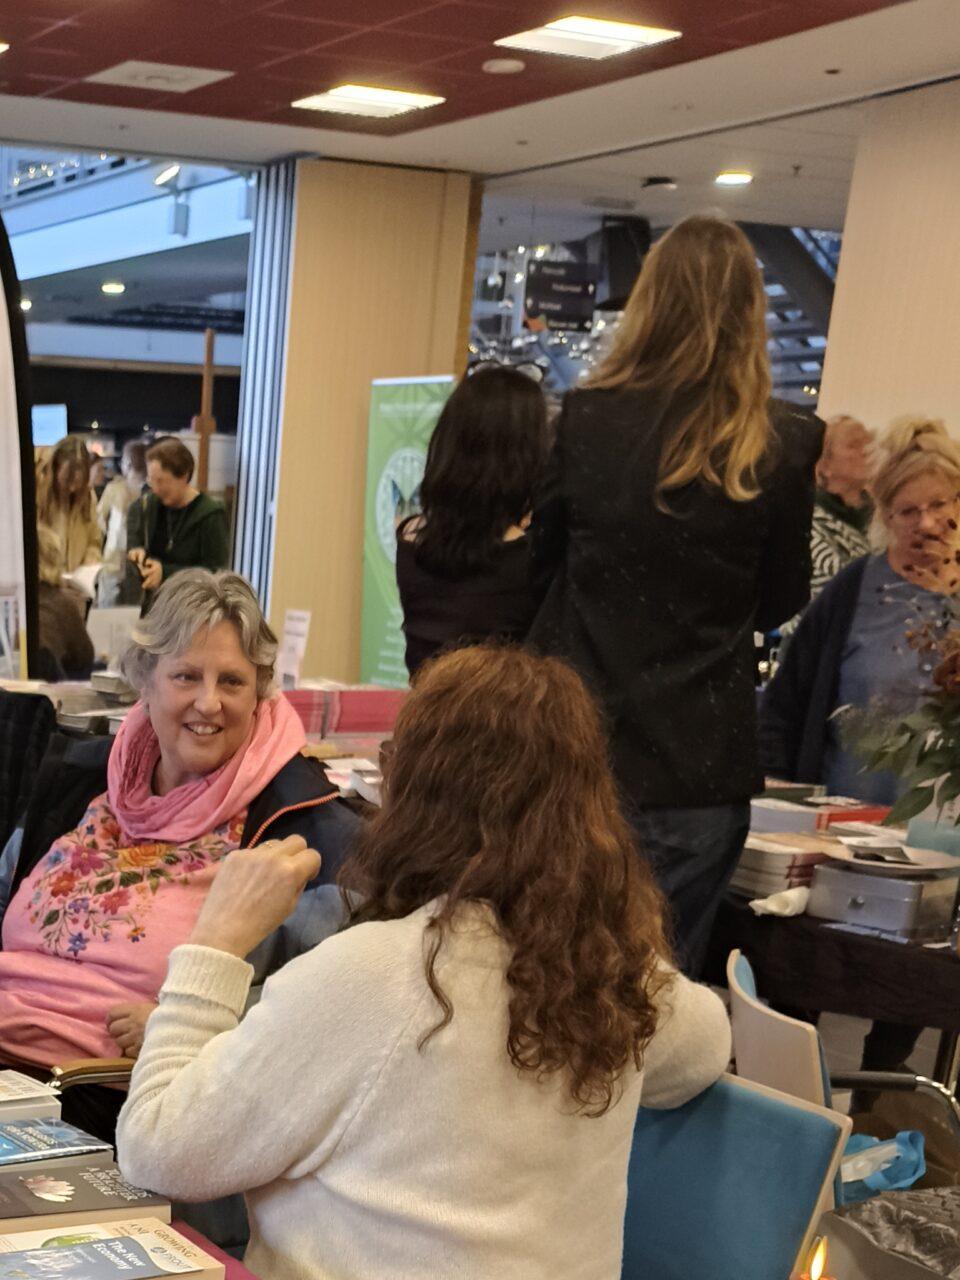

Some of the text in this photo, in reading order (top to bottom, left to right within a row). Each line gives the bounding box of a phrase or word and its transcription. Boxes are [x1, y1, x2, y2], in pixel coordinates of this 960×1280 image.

[78, 1171, 117, 1195] FUTURE
[92, 1242, 132, 1269] Economy
[107, 1240, 146, 1266] The New
